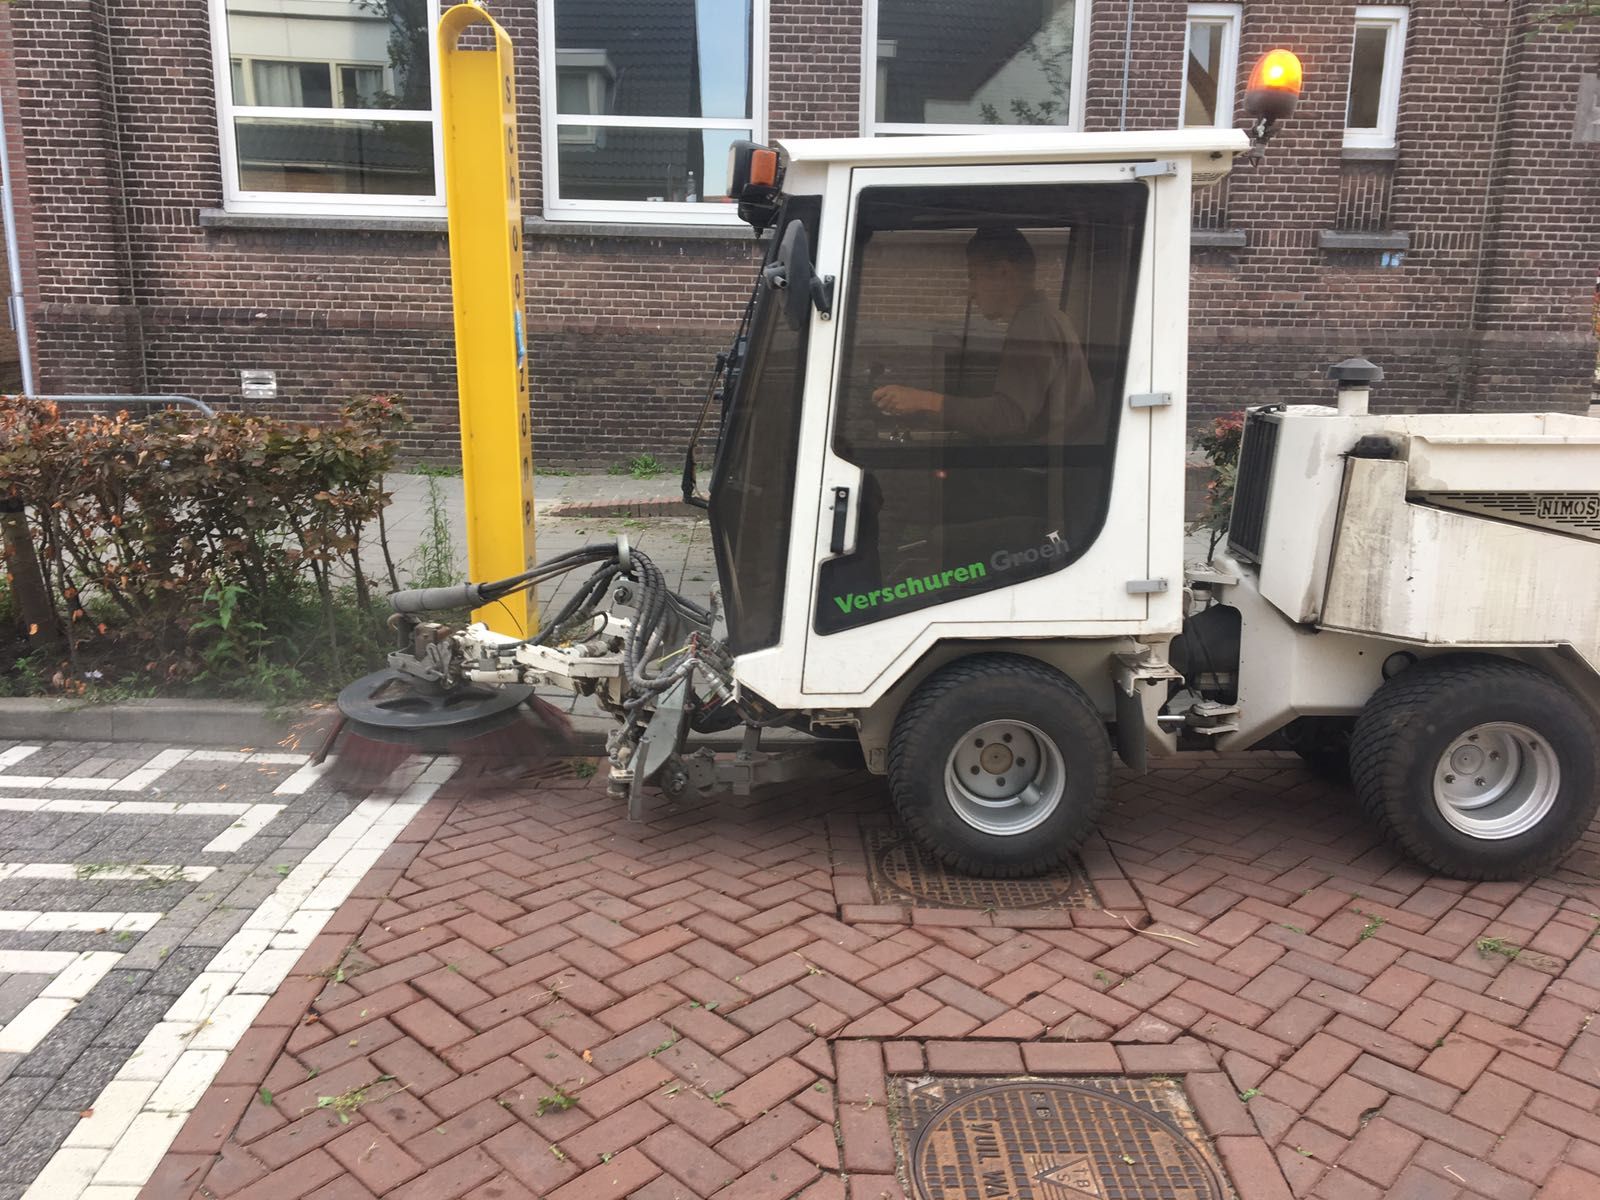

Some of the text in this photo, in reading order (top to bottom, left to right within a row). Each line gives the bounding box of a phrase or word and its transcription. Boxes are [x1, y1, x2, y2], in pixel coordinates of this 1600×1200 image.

[1541, 500, 1597, 516] NIMOS
[834, 538, 1070, 614] Verschuren Groen
